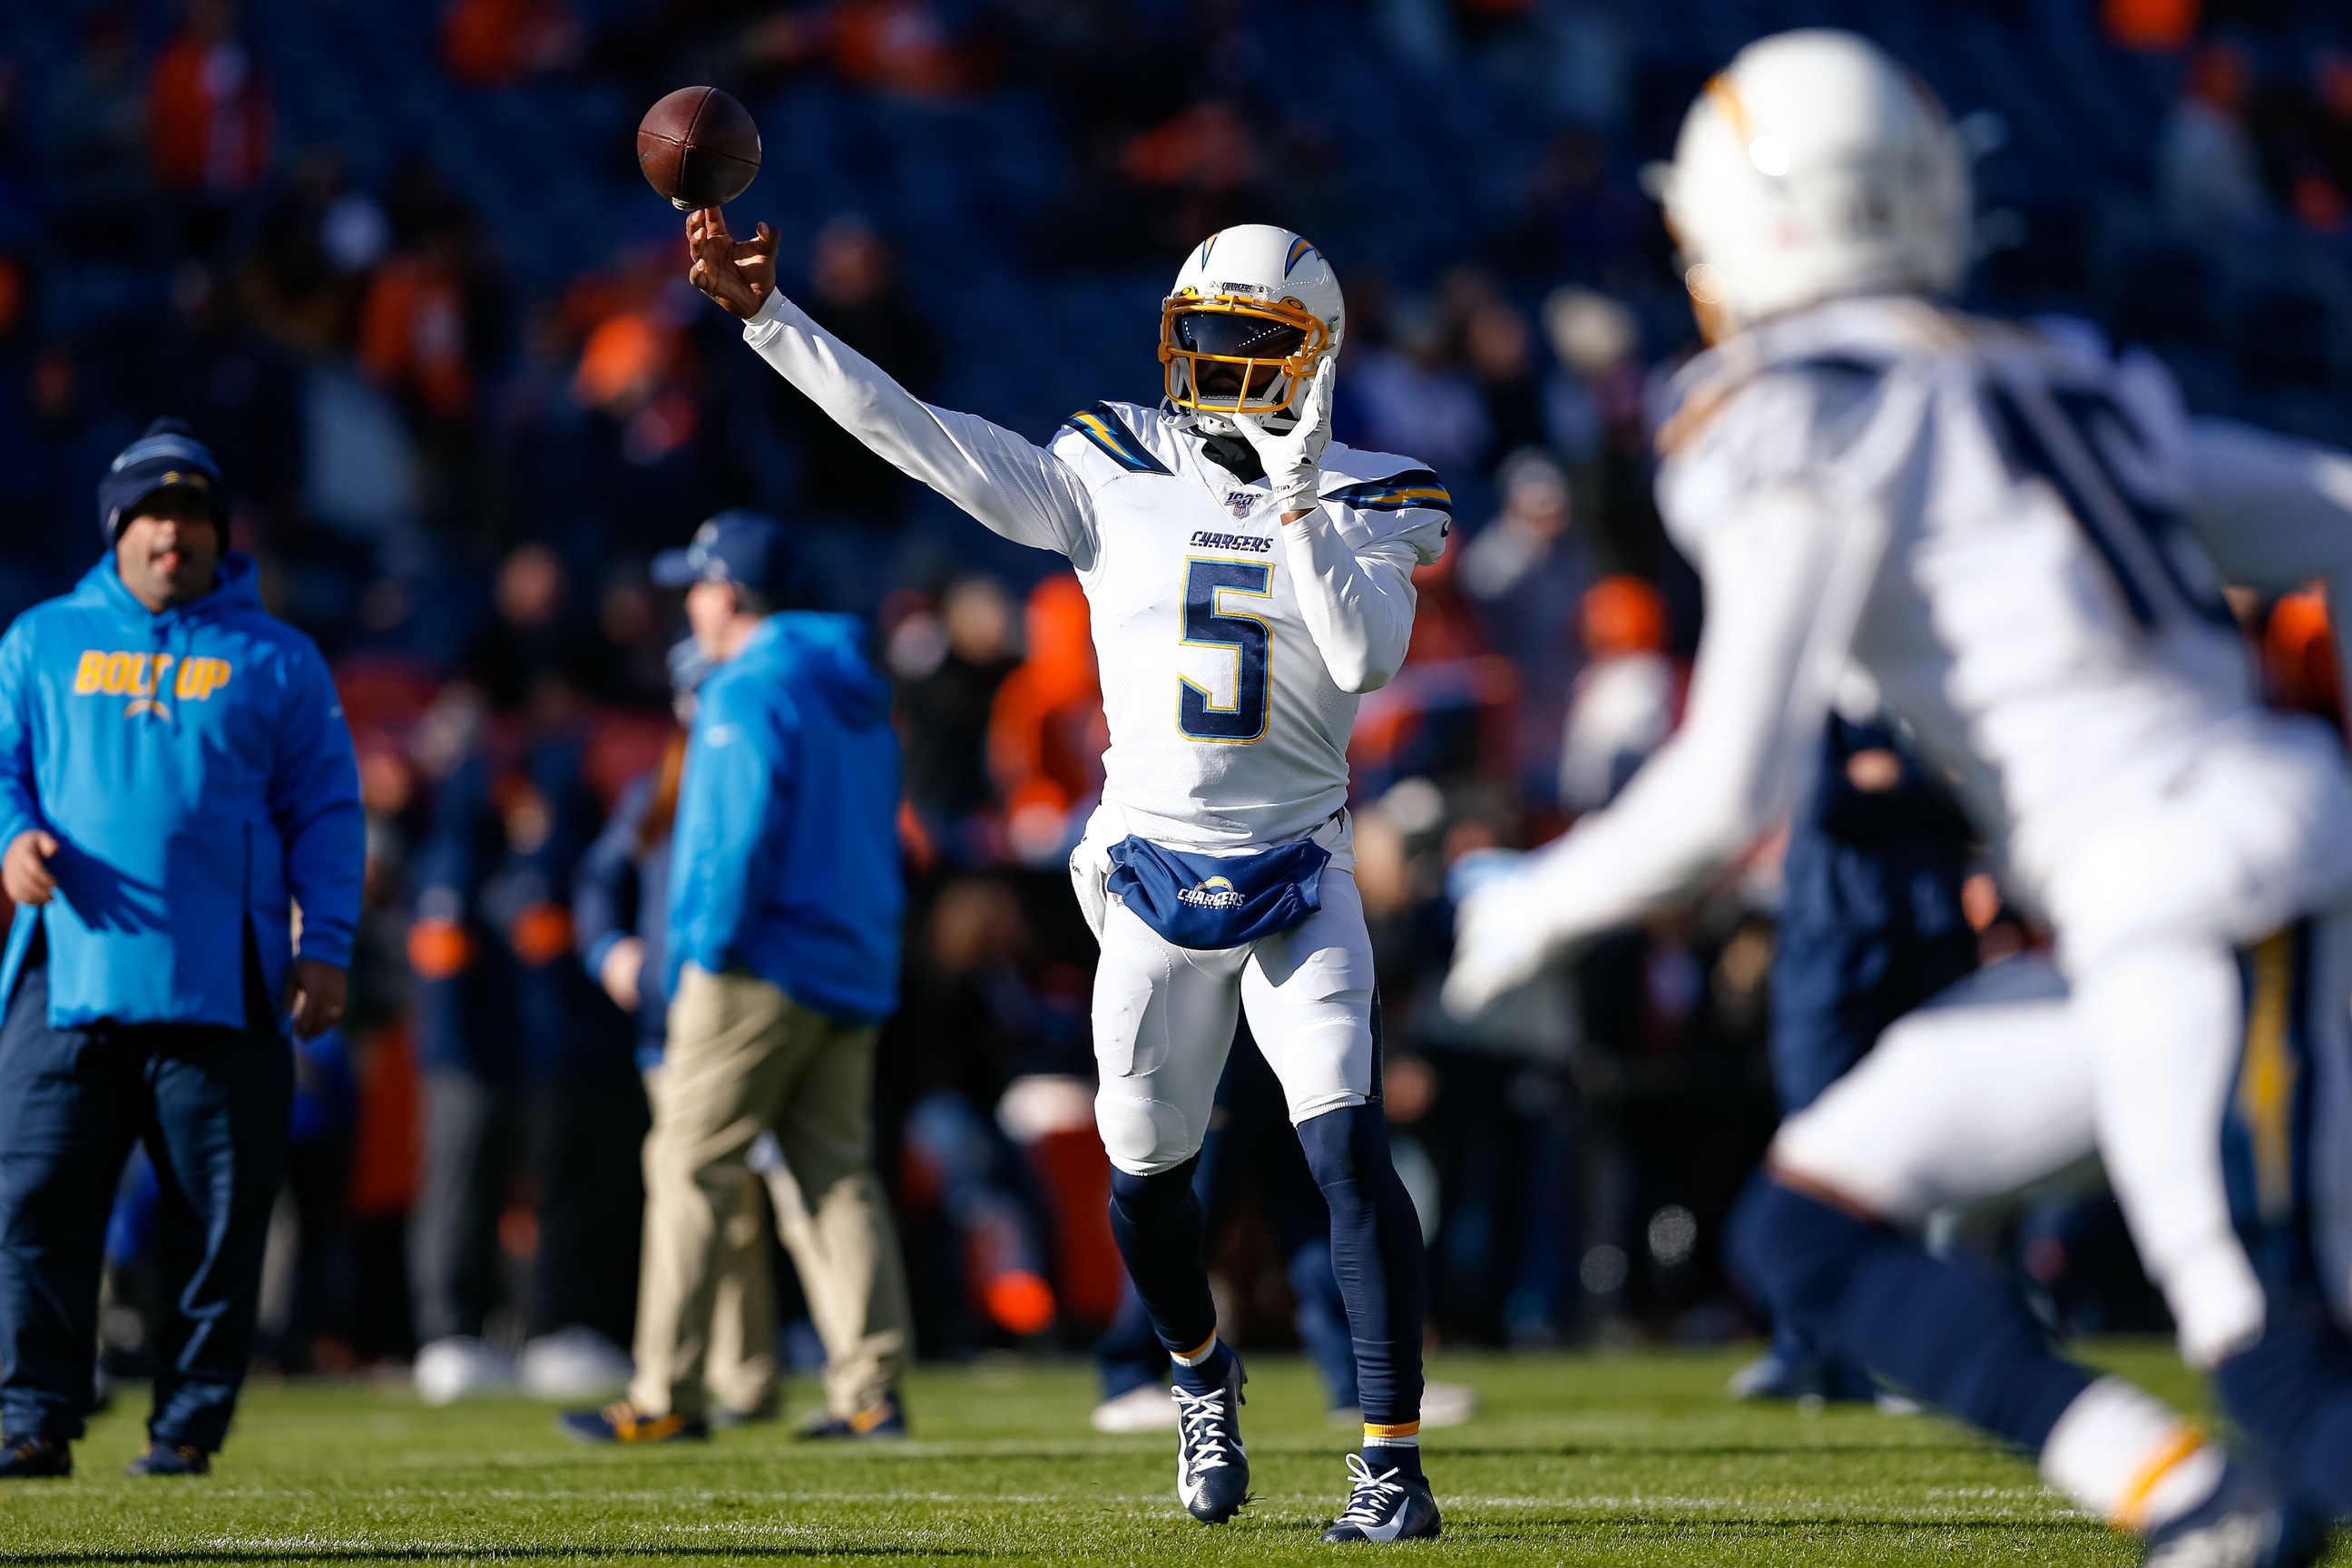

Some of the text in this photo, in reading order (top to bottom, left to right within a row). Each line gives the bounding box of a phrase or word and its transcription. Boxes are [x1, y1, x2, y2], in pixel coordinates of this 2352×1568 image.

[1221, 282, 1253, 293] CHARGERS
[1189, 531, 1274, 553] CHARGERS
[1175, 554, 1274, 745] 5
[74, 650, 232, 701] BOLT UP
[1177, 888, 1246, 906] CHARGERS
